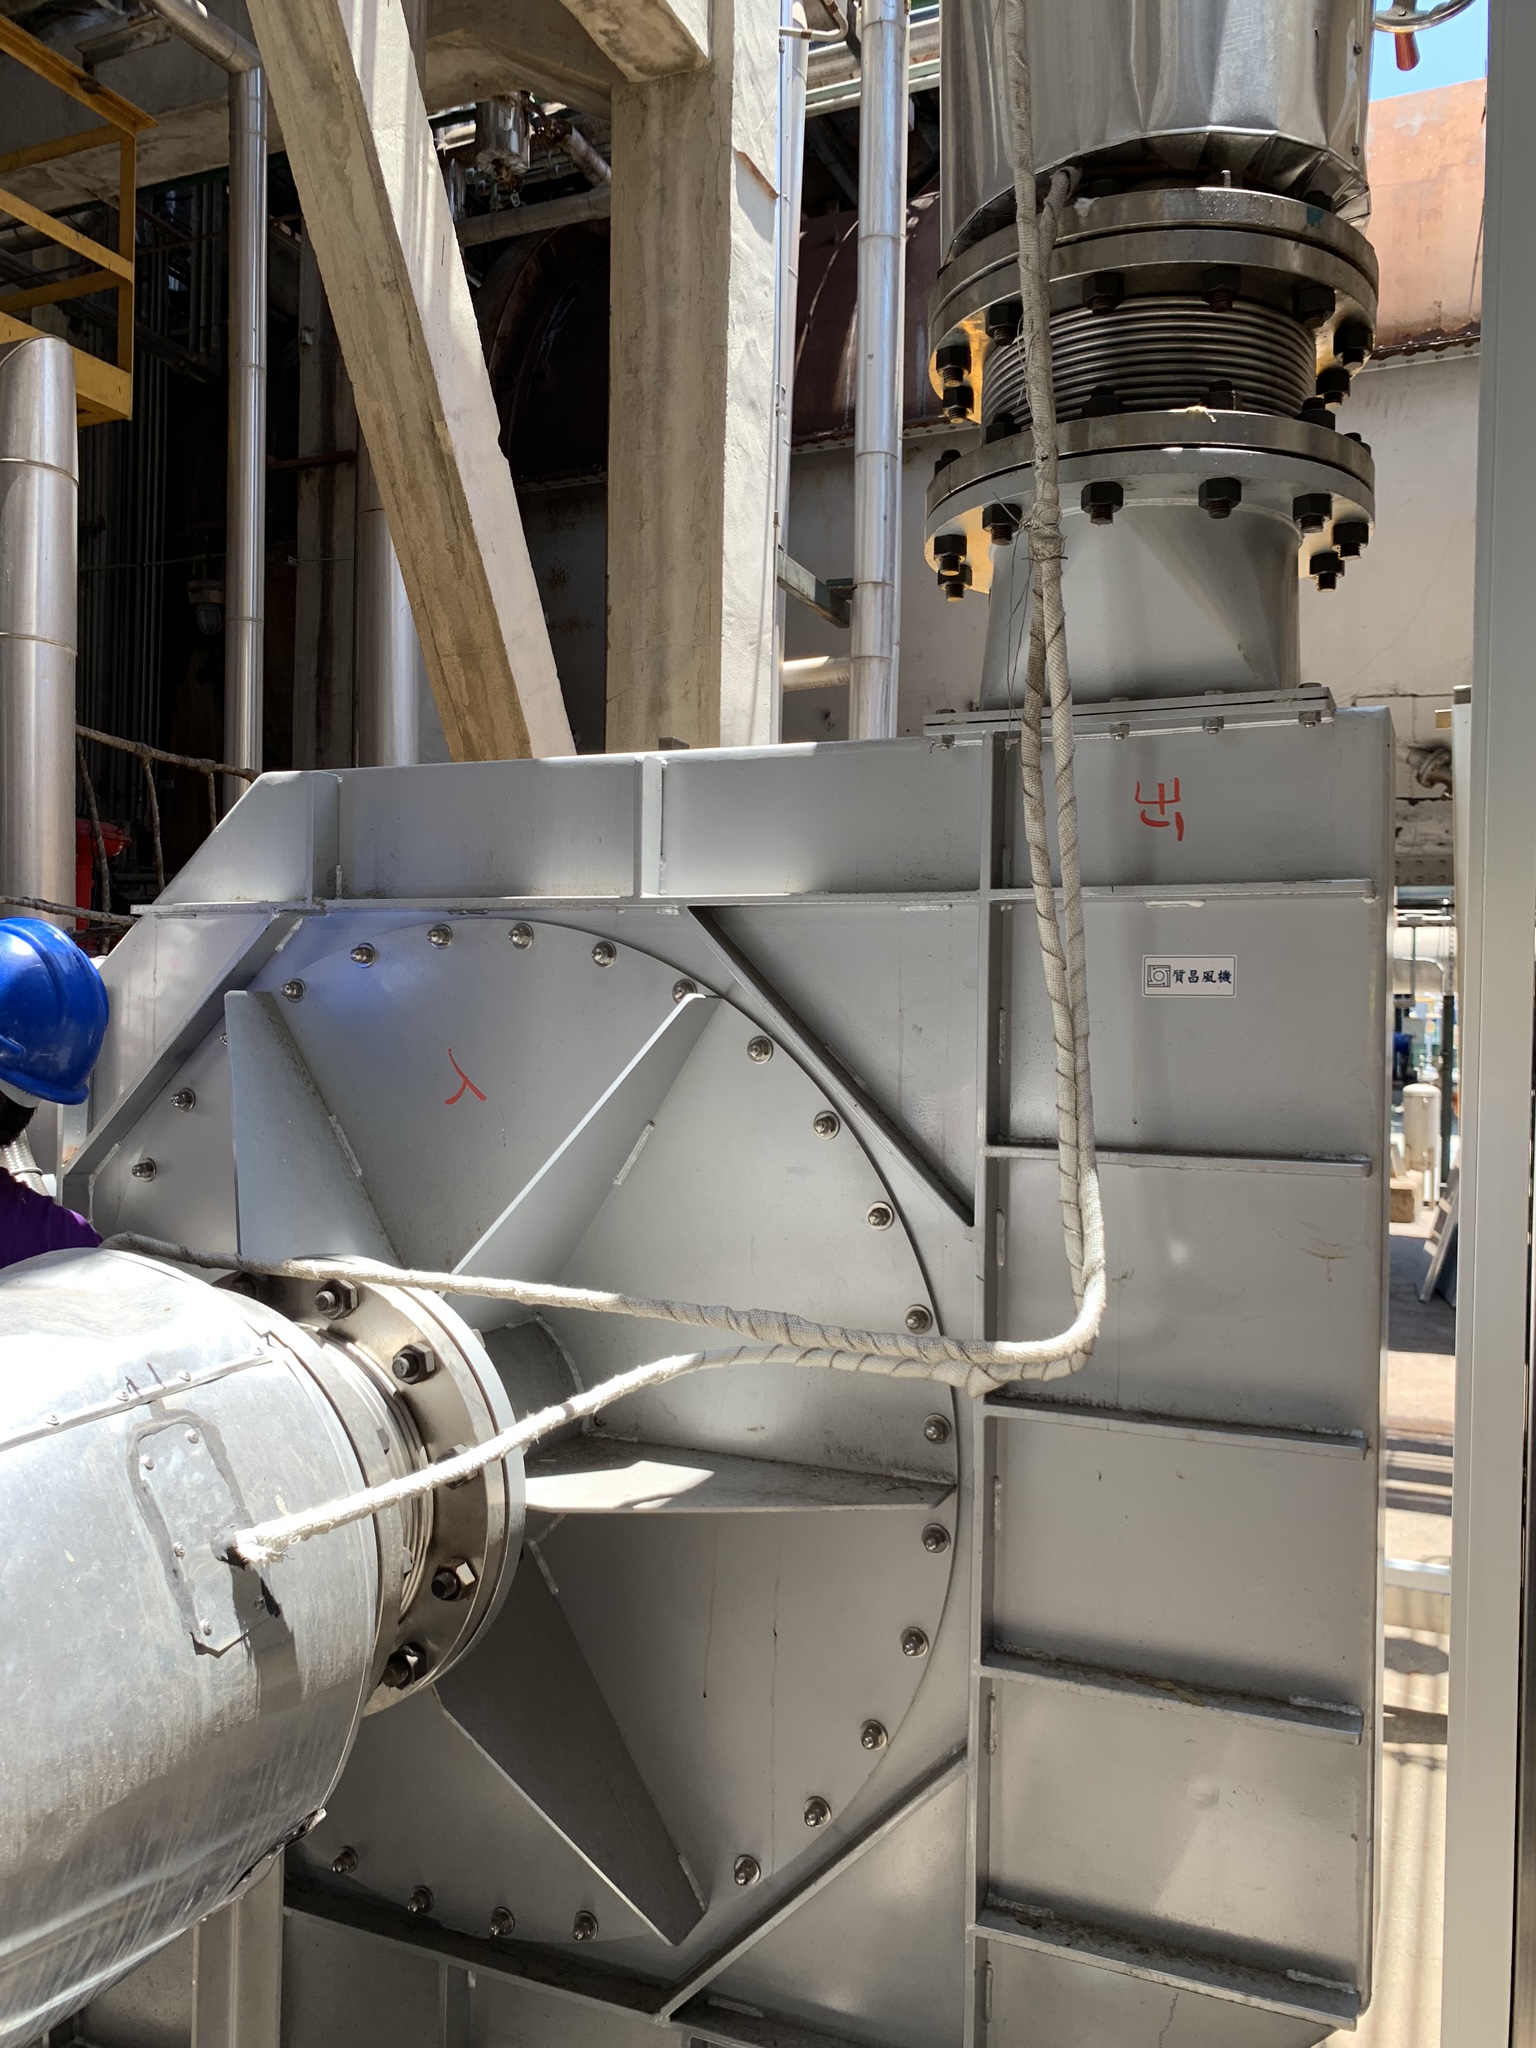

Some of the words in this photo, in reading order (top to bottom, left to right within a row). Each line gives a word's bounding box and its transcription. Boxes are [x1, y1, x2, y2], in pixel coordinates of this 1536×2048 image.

[1135, 777, 1184, 842] 出
[1172, 968, 1232, 984] 質昌風機
[444, 1048, 487, 1105] 入
